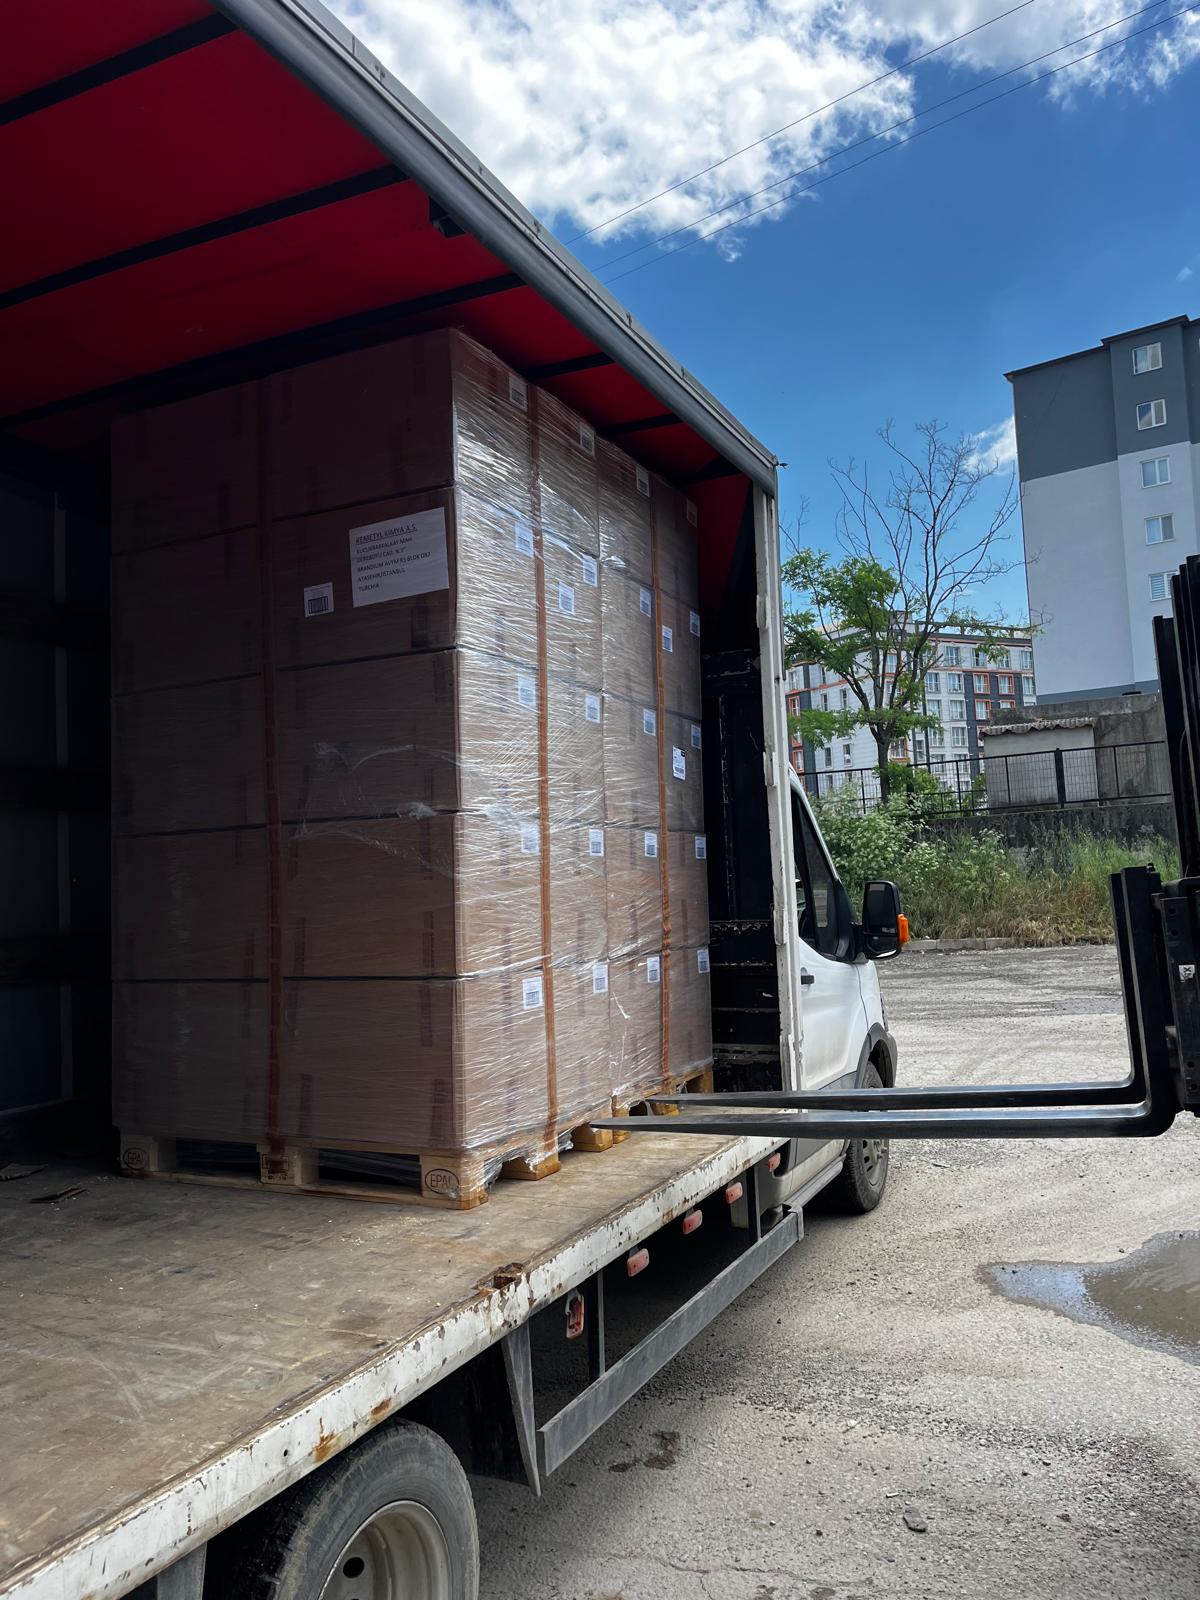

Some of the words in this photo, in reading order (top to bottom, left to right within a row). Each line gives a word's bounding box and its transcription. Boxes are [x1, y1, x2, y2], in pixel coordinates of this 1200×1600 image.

[356, 532, 383, 543] KEMETYL
[384, 526, 404, 536] KIMYA
[357, 561, 383, 572] BRANDIUM
[358, 583, 379, 592] TURCHIA
